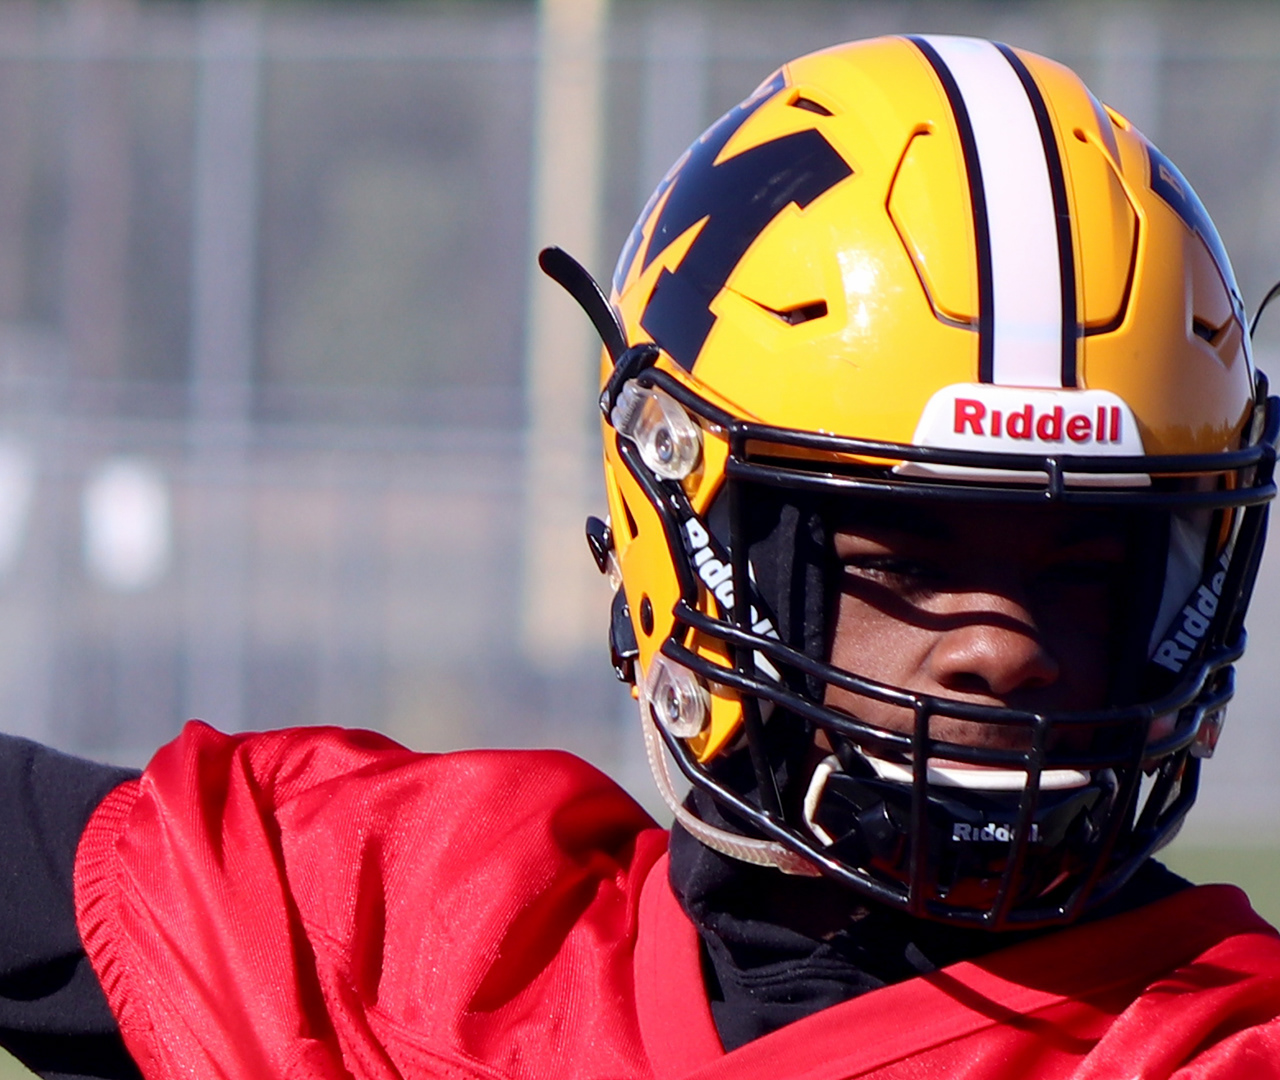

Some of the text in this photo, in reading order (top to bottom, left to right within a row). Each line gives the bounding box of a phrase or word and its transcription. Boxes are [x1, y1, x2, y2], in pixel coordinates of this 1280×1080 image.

[953, 397, 1121, 443] Riddell
[684, 516, 781, 640] Riddl
[952, 822, 1039, 842] Riddl
